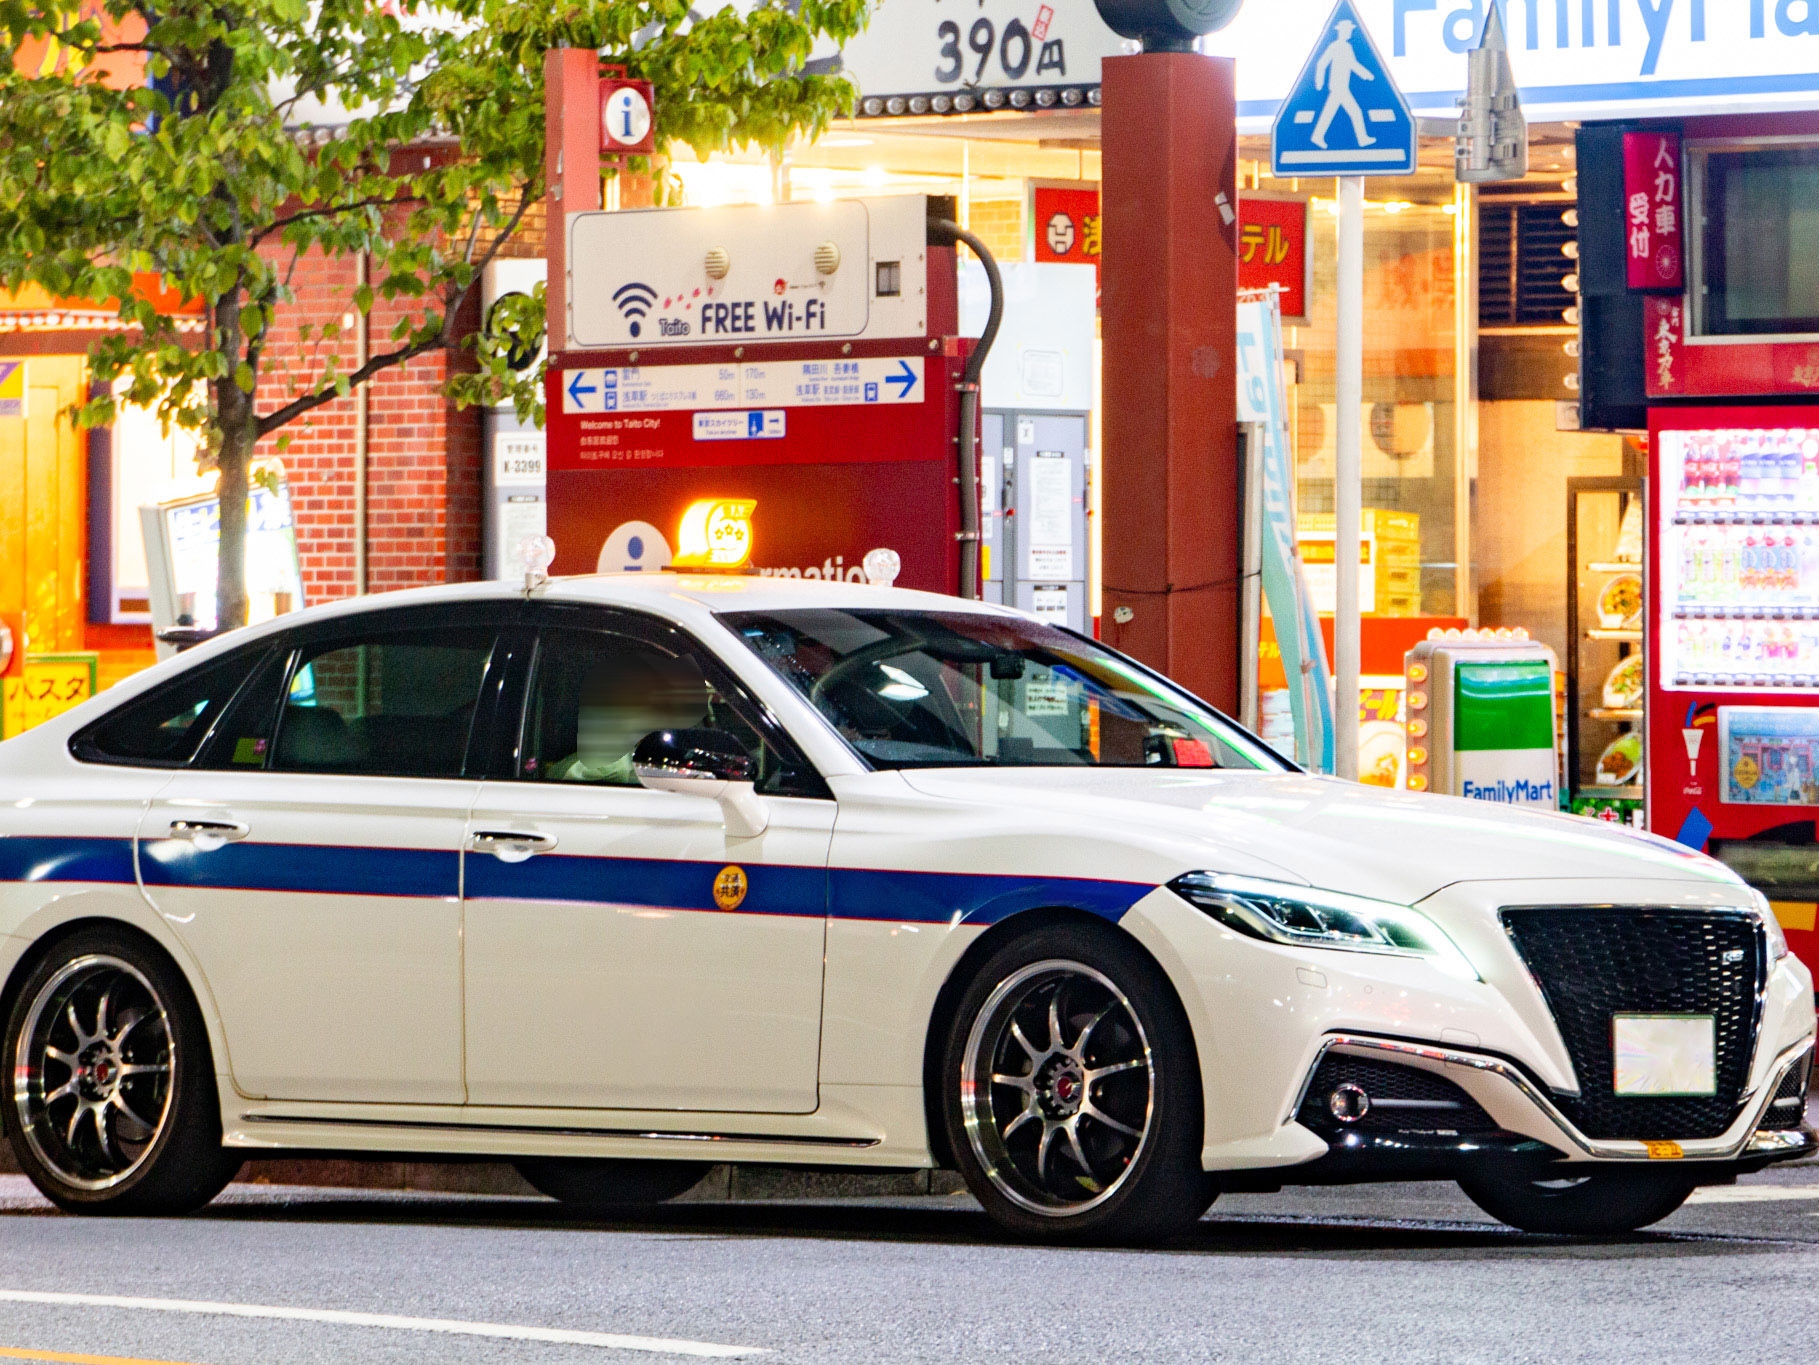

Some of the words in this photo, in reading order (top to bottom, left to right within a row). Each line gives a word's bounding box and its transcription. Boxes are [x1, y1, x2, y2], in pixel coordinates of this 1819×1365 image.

[935, 17, 1066, 85] 390円
[1654, 138, 1676, 236] 人力車
[1629, 192, 1650, 259] 受付
[659, 318, 691, 336] Taito
[701, 301, 756, 334] FREE
[764, 298, 826, 331] Wi-Fi
[580, 420, 613, 430] Welcome
[614, 420, 622, 429] to
[623, 418, 642, 429] Taito
[504, 459, 541, 473] K-3399
[1463, 779, 1553, 804] FamilyMart
